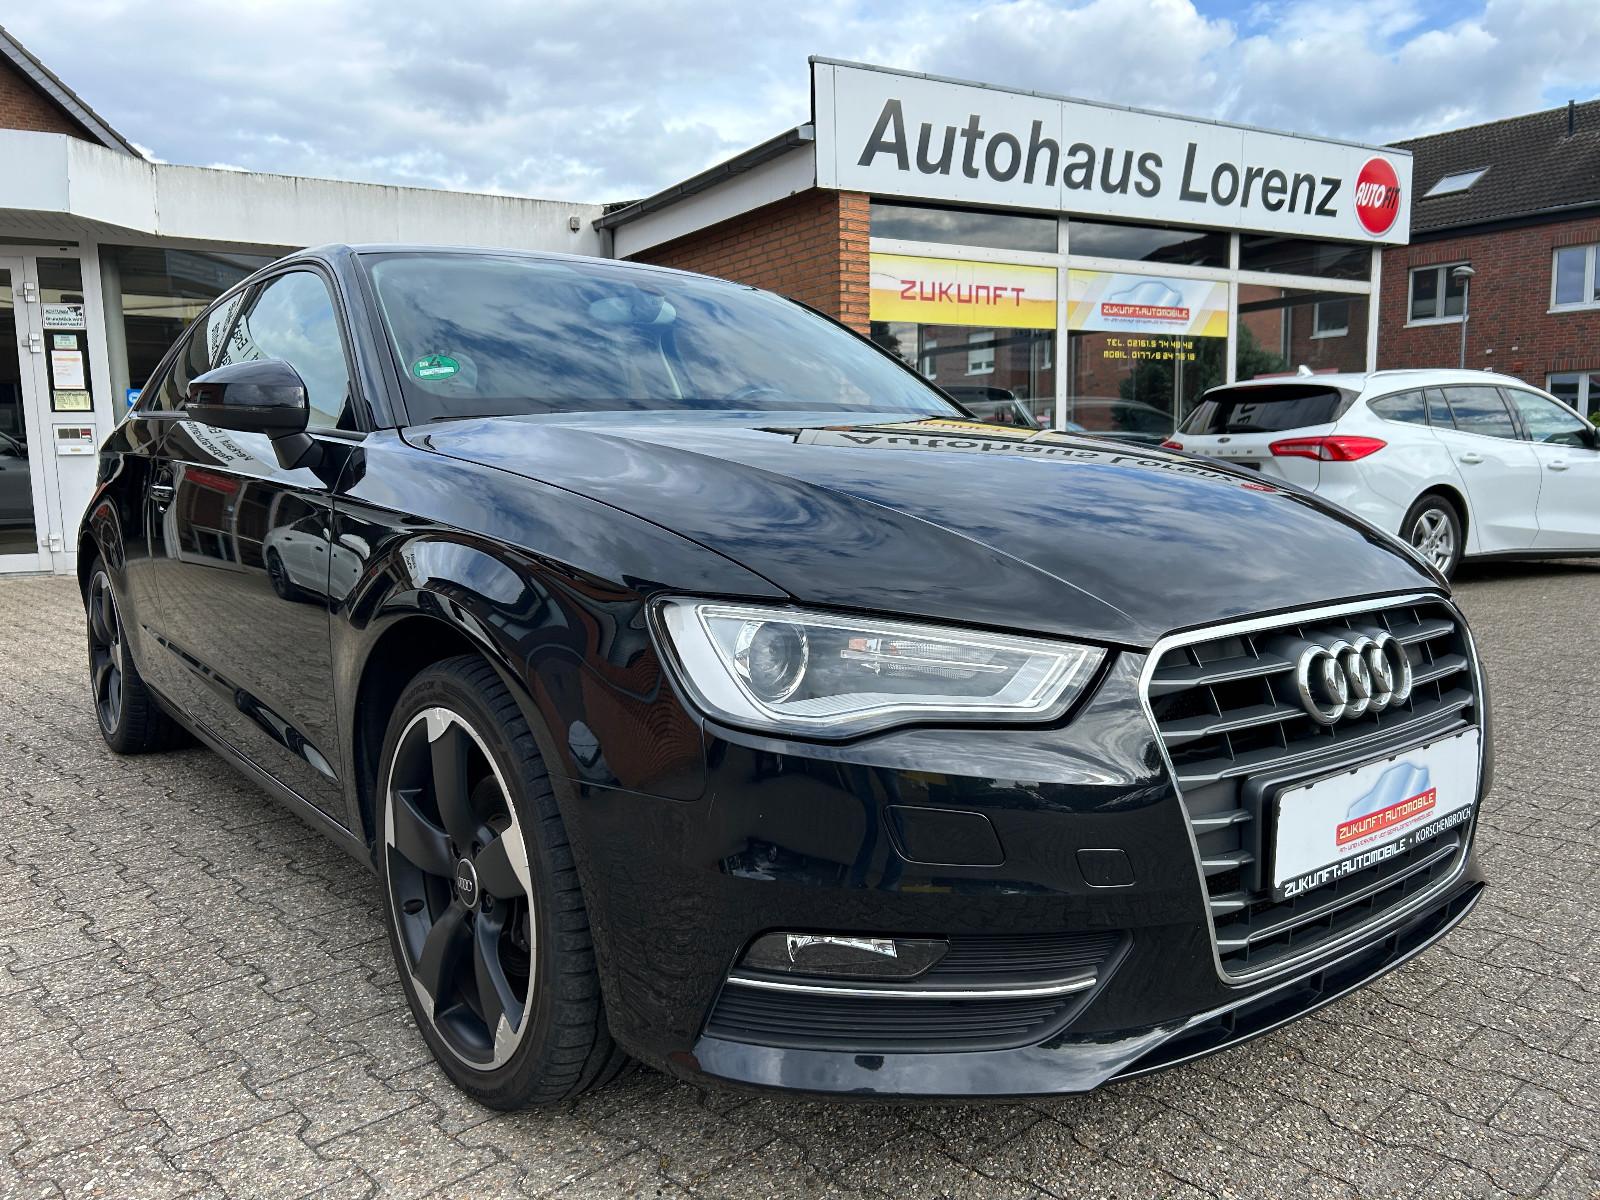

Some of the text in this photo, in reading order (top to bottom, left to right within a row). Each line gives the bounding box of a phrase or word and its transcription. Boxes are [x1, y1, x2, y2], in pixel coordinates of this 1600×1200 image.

[857, 98, 1342, 217] Autohaus Lorenz
[900, 279, 1025, 307] ZUKUNFT
[1106, 338, 1125, 347] TEL.
[1103, 350, 1130, 359] MOBIL.
